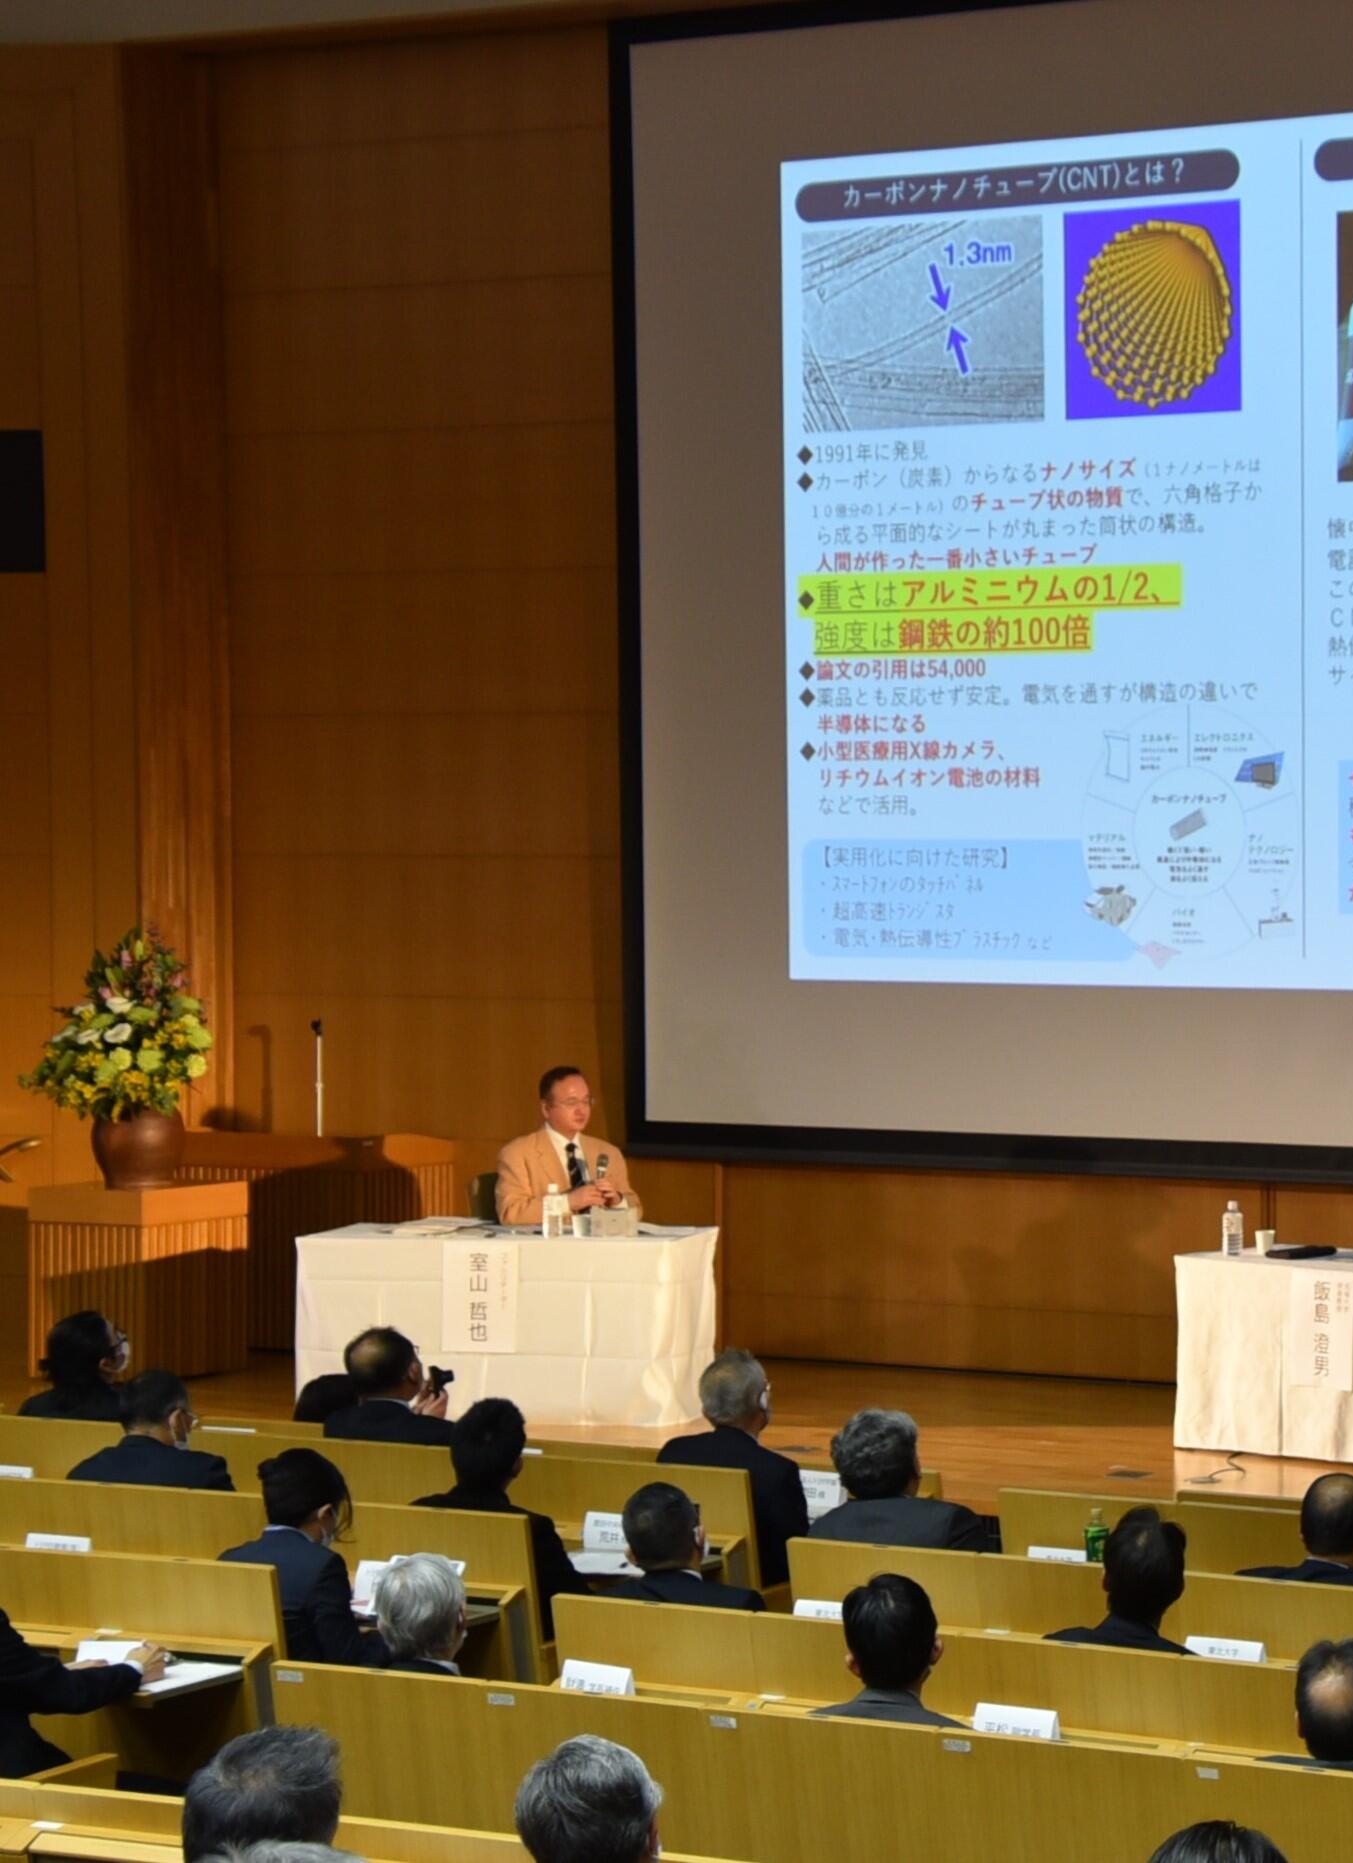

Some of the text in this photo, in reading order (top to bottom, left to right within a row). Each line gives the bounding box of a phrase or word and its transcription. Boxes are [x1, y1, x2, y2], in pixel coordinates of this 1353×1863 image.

[844, 157, 1186, 210] カーボンナノチューブ(CNT)とは？
[944, 242, 1014, 268] 1.3nm
[815, 440, 929, 465] 1991年に発見
[816, 512, 1206, 546] ら成る平面的なシートが丸まった筒状の構造。
[815, 543, 1099, 573] 人間が作った一番小さいチューブ
[817, 571, 1162, 611] 重さはアルミニウムの1/2、
[815, 613, 1091, 651] 強度は鋼鉄の約100倍
[816, 659, 986, 681] 論文の引用は54,000
[816, 681, 1258, 708] 薬品とも反応せず安定。電気を通すが構造の違いで
[817, 714, 926, 734] 半導体になる
[817, 740, 1006, 762] 小型医療用X線カメラ、
[819, 767, 1041, 788] リチウムイオン電池の材料
[818, 794, 918, 816] などで活用。
[822, 845, 1008, 869] 【実用化に向けた研究】
[468, 1252, 489, 1343] 室山 哲也
